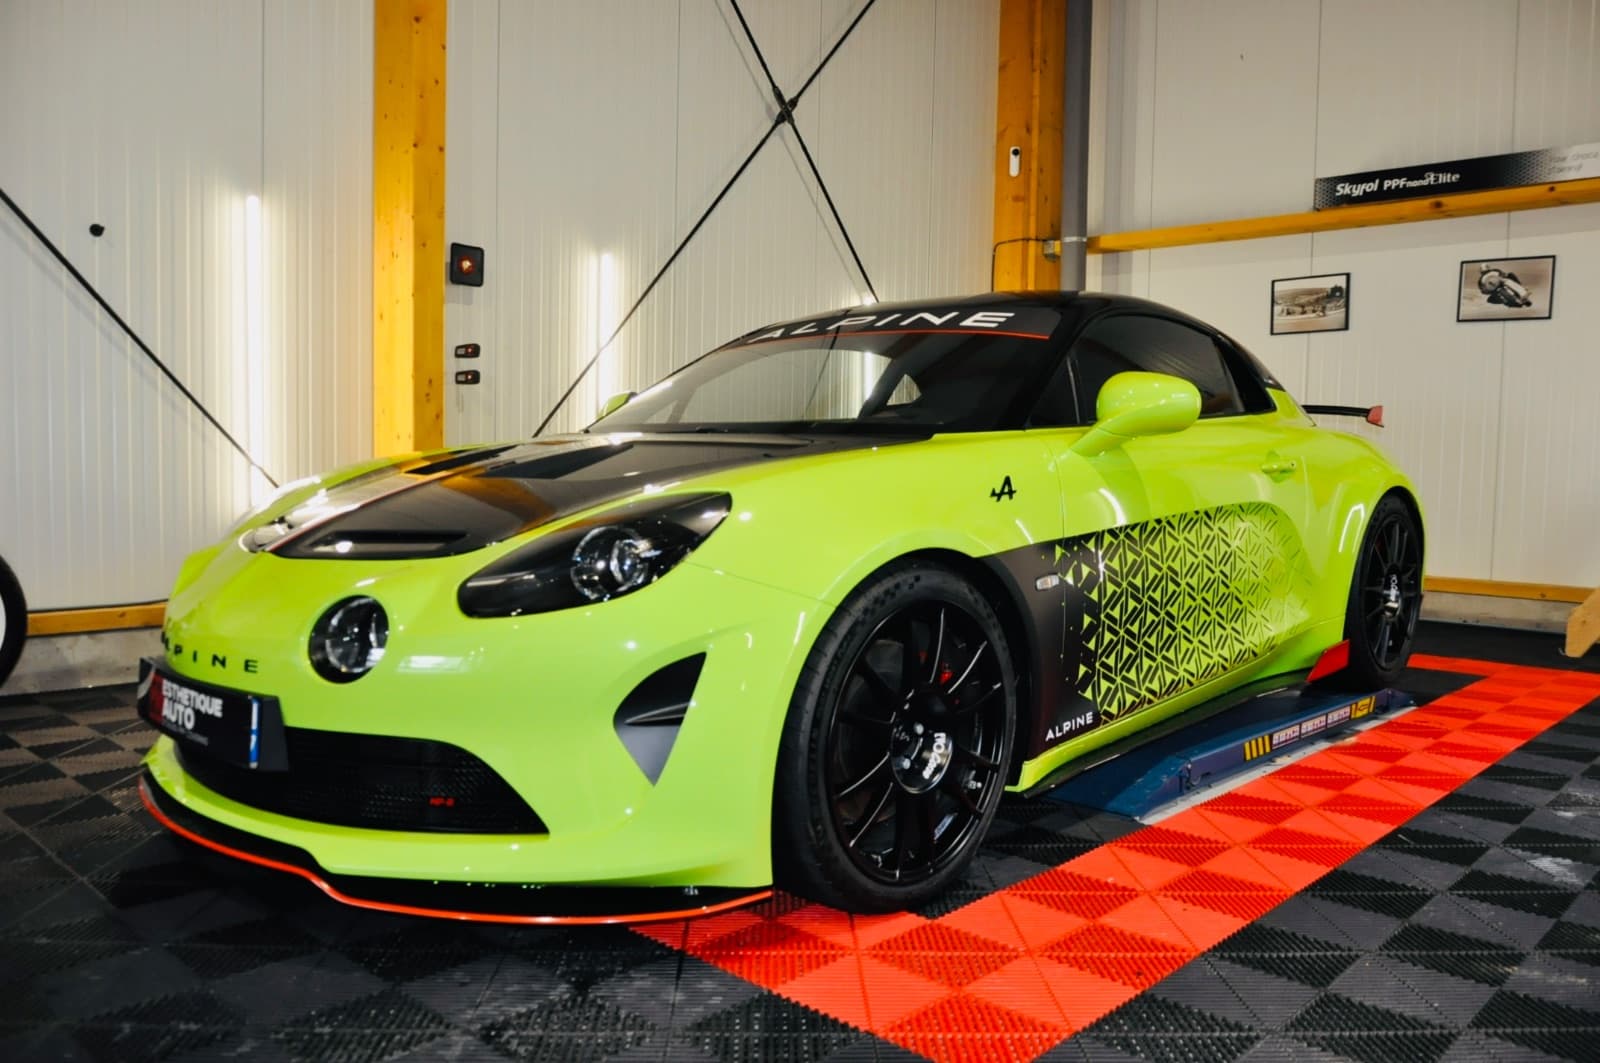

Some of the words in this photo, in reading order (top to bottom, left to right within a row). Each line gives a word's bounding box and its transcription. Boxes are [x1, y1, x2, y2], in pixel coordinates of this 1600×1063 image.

[1335, 179, 1379, 197] Skyfol
[748, 311, 1015, 344] ALPINE
[162, 697, 195, 730] AUTO
[1045, 711, 1093, 742] ALPINE
